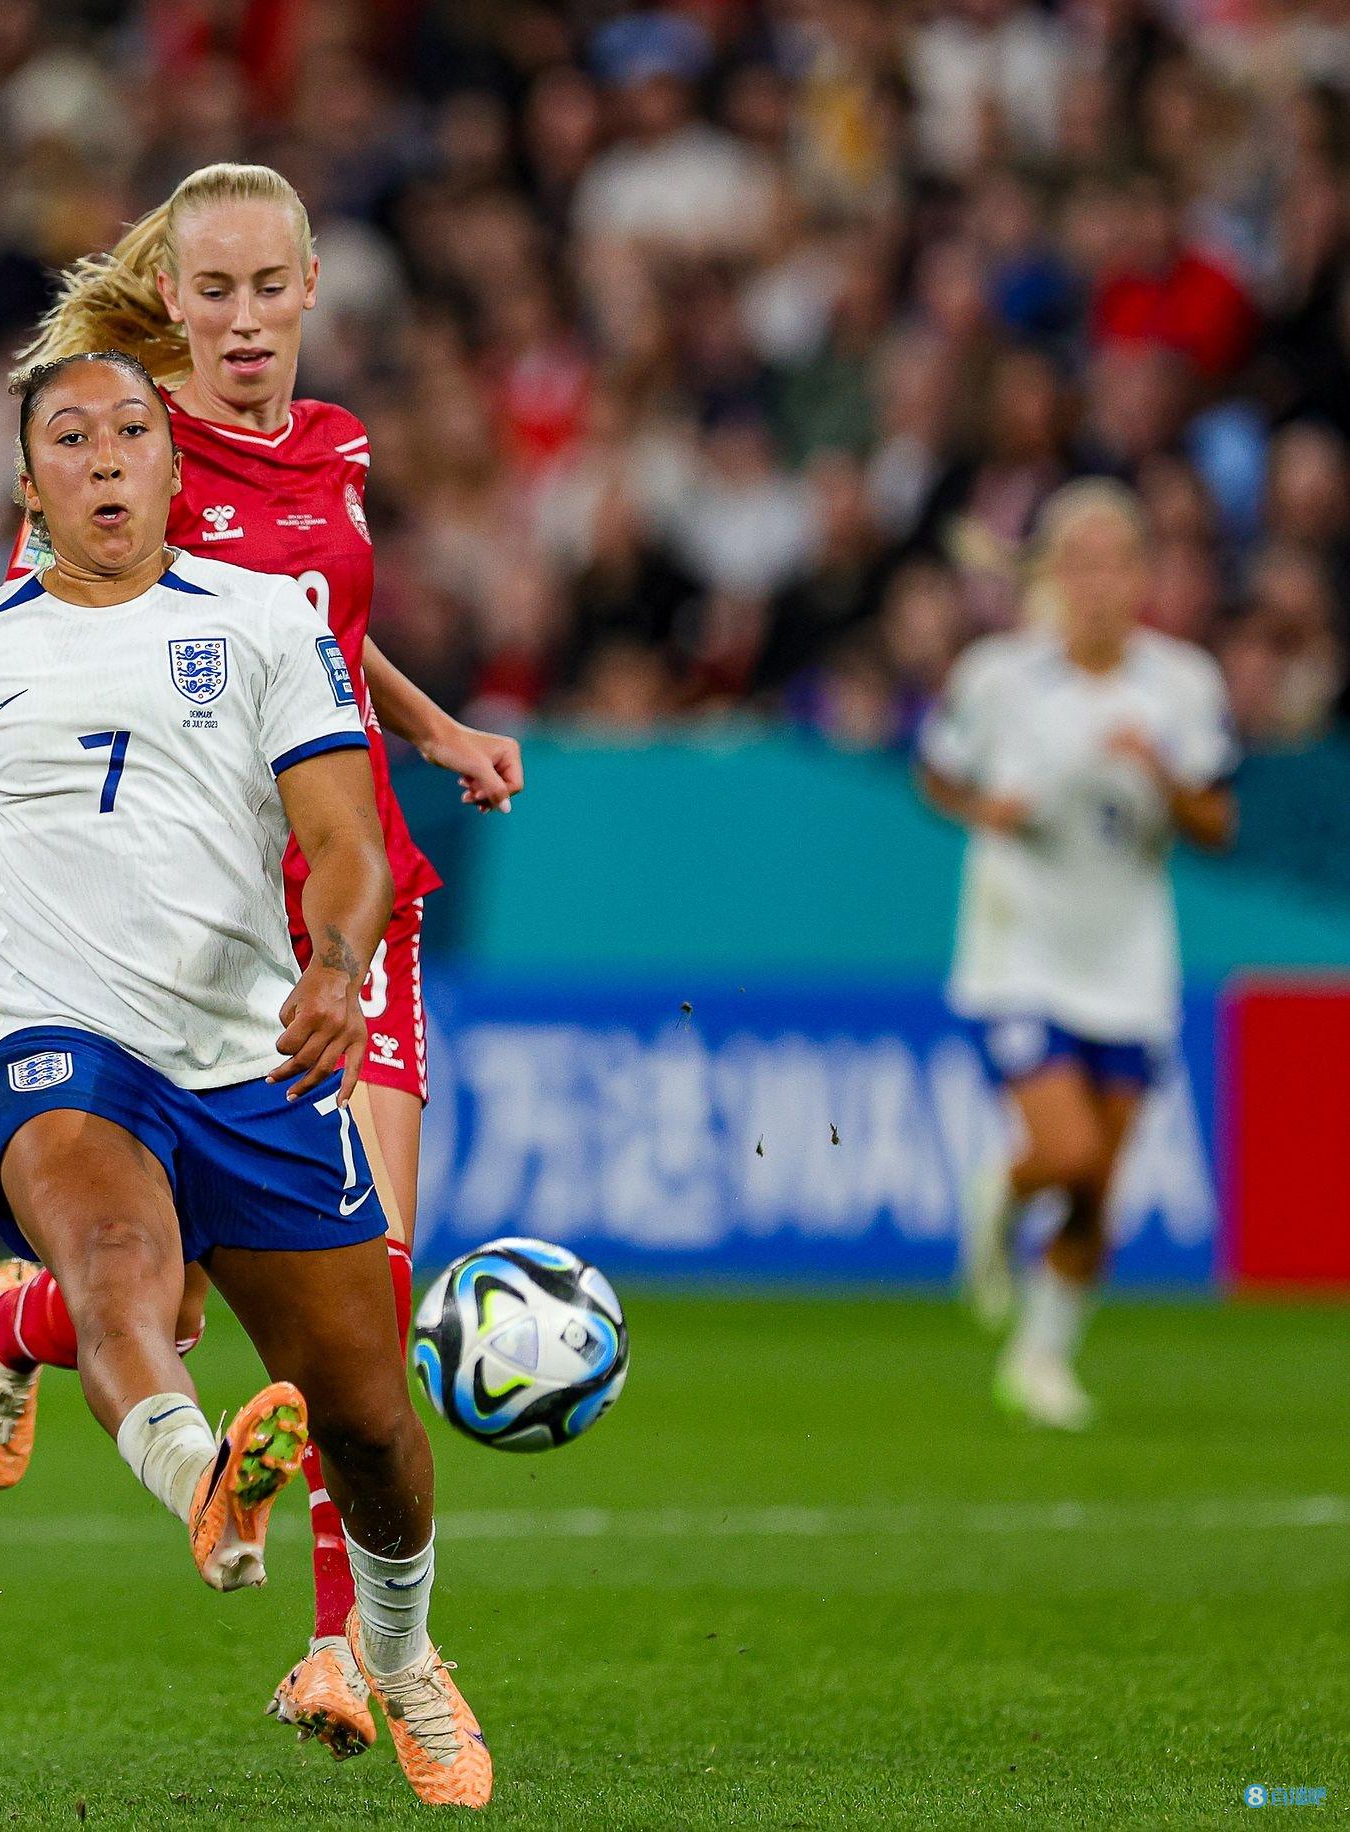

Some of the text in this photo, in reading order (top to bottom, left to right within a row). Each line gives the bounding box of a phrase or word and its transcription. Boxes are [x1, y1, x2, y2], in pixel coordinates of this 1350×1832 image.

[202, 526, 244, 542] hummel
[190, 710, 213, 718] DENMARK
[182, 719, 218, 728] 28 JULY 2023
[77, 730, 131, 813] 7
[313, 1089, 357, 1190] 7
